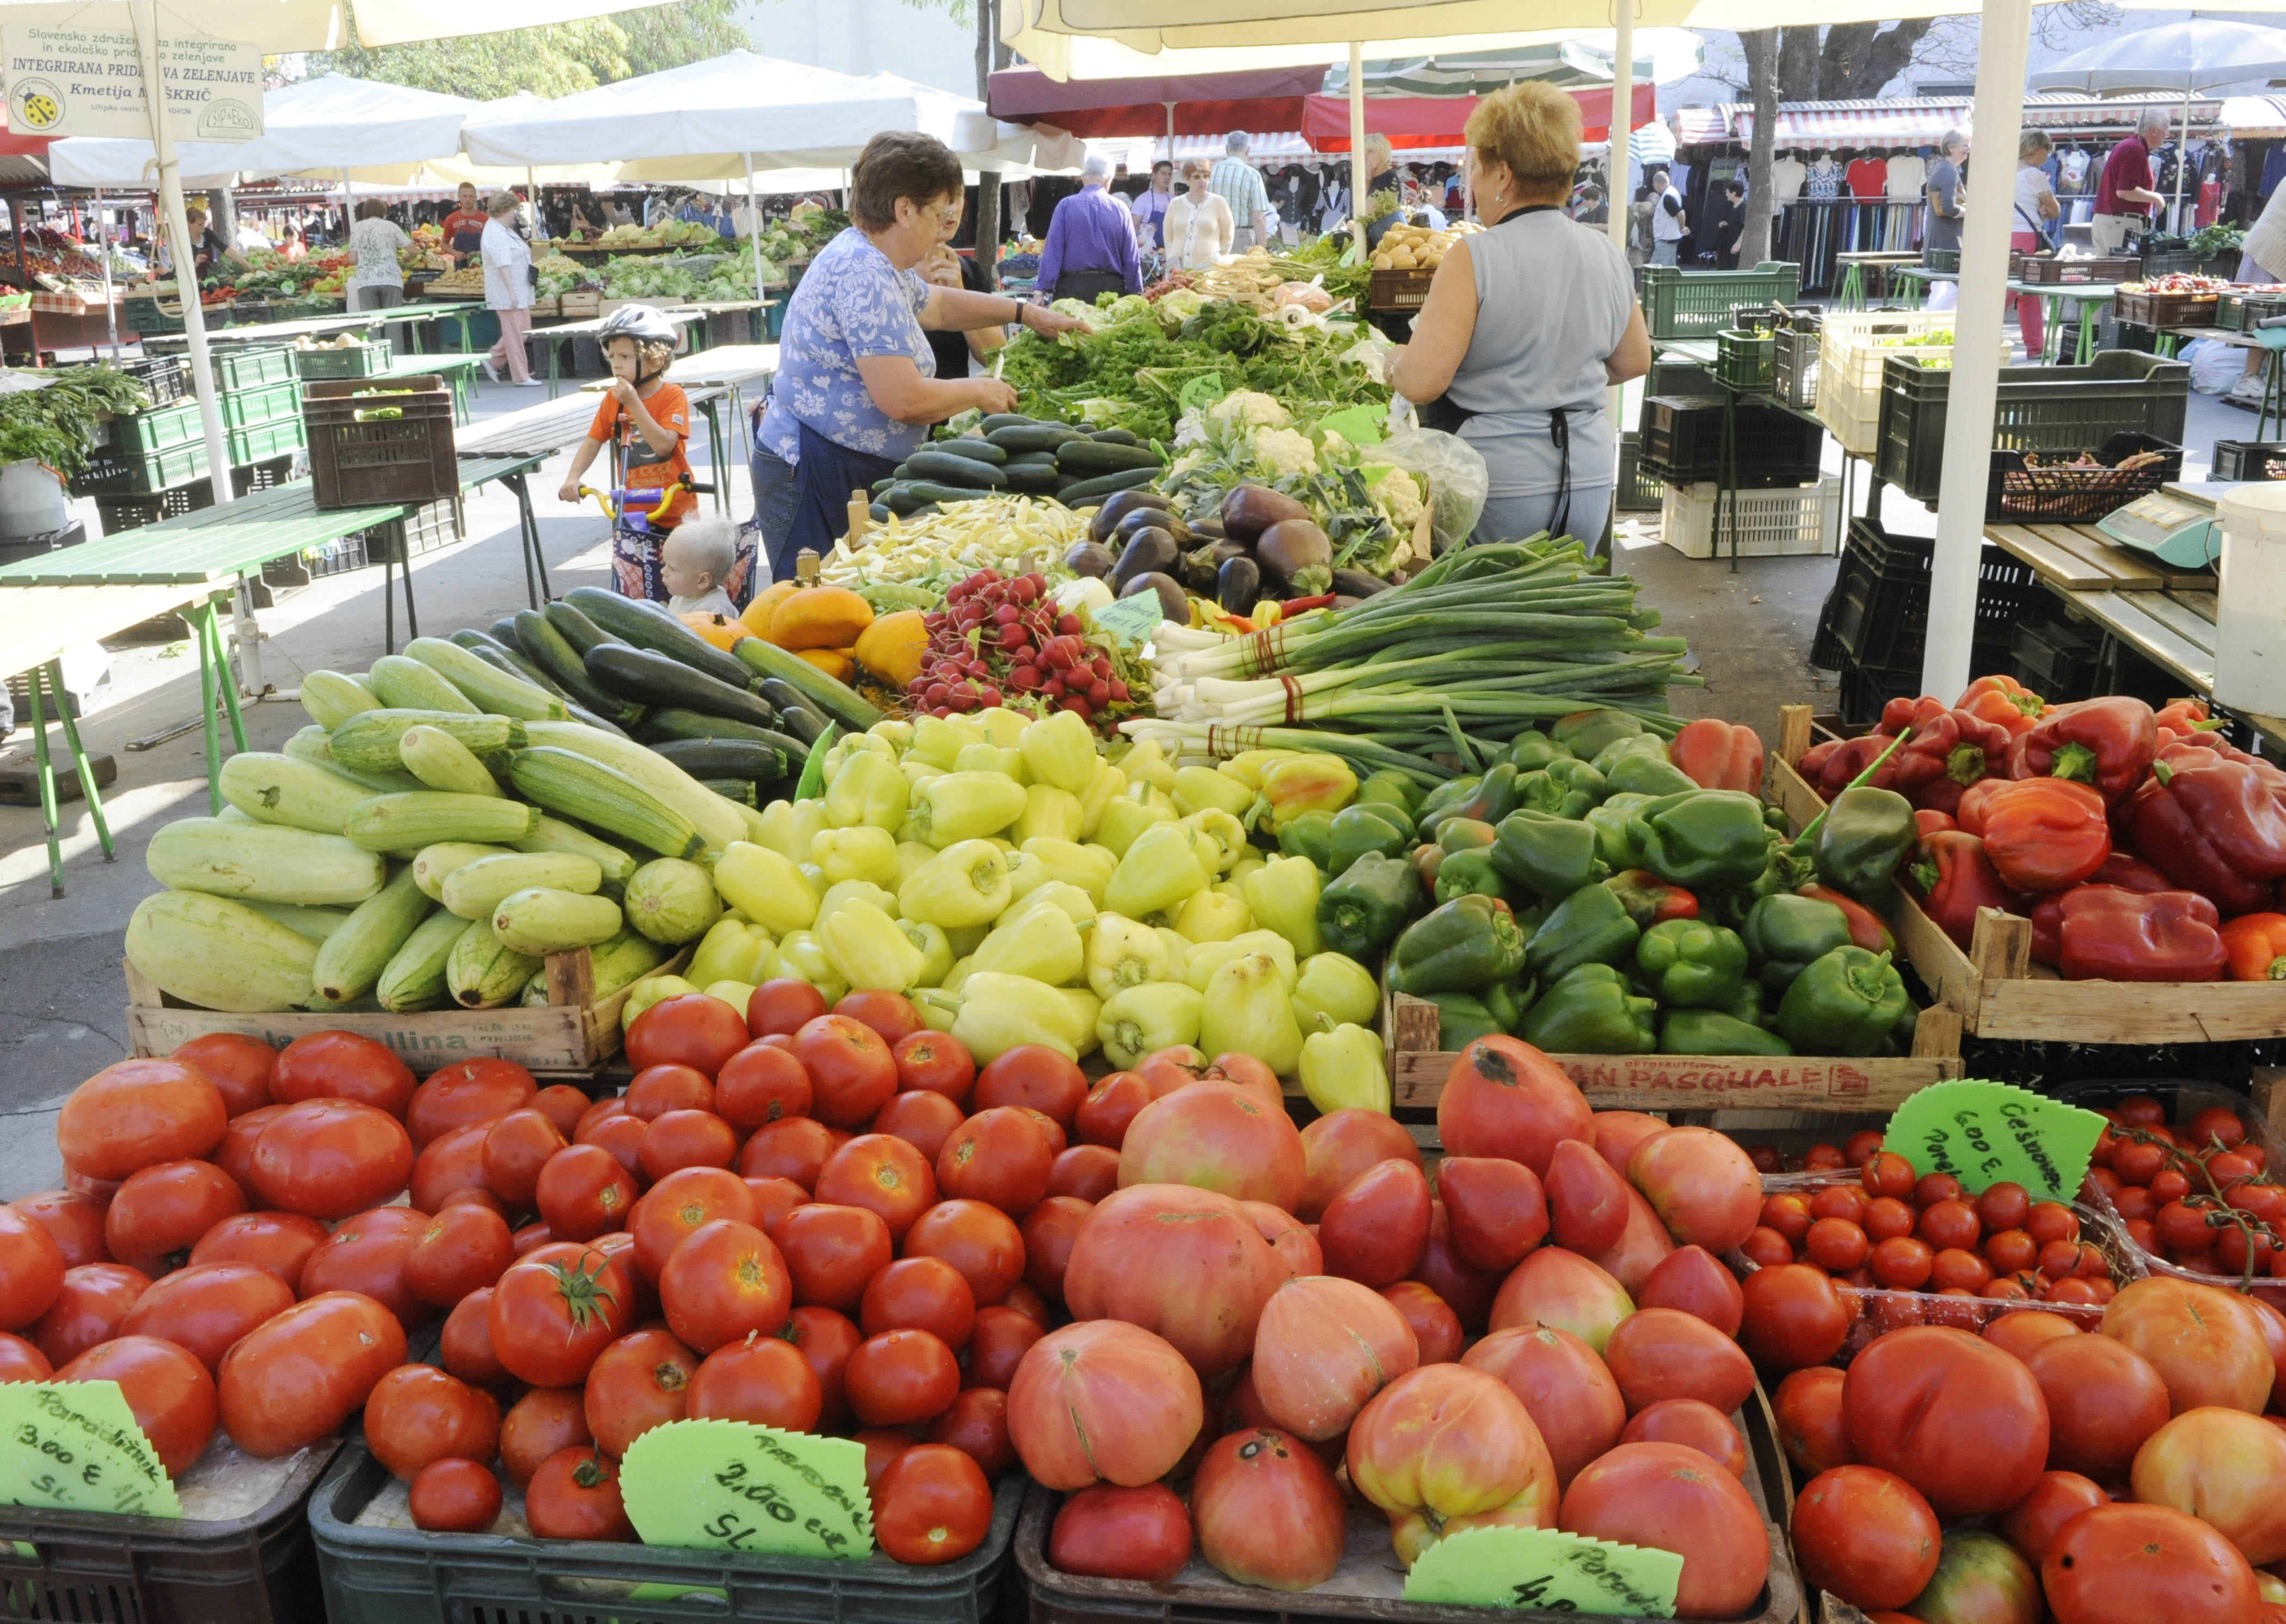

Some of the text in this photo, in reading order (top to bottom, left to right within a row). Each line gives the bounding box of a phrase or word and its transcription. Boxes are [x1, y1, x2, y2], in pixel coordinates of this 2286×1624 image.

[28, 29, 87, 42] Slovensko
[157, 39, 169, 47] za
[175, 39, 237, 52] integrirano
[42, 43, 53, 53] in
[58, 44, 108, 56] ekološko
[172, 51, 225, 64] zelenjave
[13, 58, 103, 75] INTEGRIRANA
[183, 69, 255, 83] ZELENJAVE
[70, 83, 132, 99] Kmetija
[138, 86, 212, 102] MŠKRIČ
[384, 1031, 468, 1050] llina
[1555, 1061, 1823, 1092] AN PASQUALE
[18, 1423, 75, 1465] 3.00
[714, 1461, 797, 1523] 2.00
